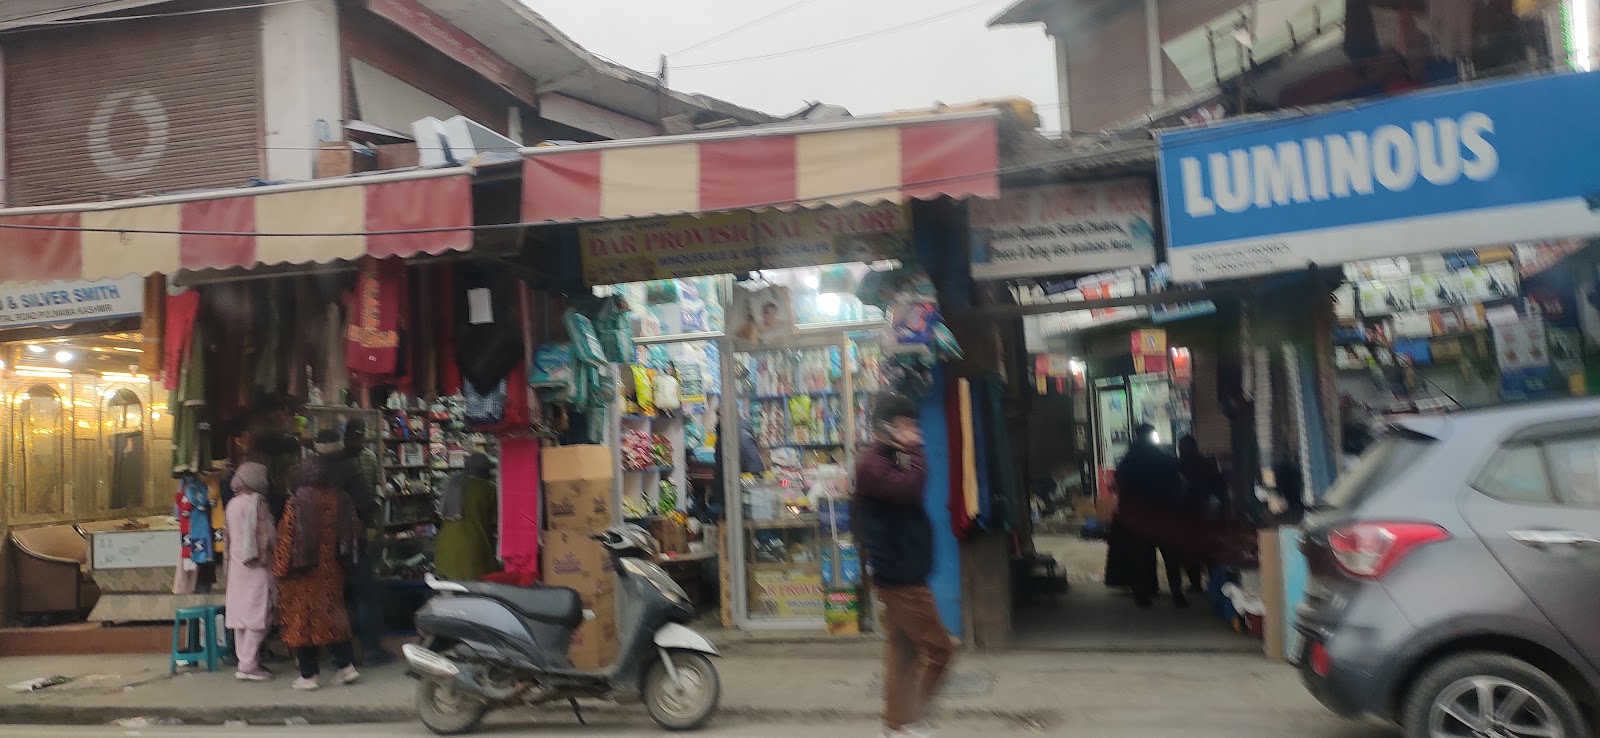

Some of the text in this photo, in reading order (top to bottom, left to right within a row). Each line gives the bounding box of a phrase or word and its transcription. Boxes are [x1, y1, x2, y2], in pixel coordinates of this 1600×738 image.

[1180, 111, 1500, 218] LUMINOUS
[815, 207, 898, 235] STORE
[7, 295, 18, 309] &
[20, 290, 72, 308] SILVER
[72, 284, 121, 303] SMITH
